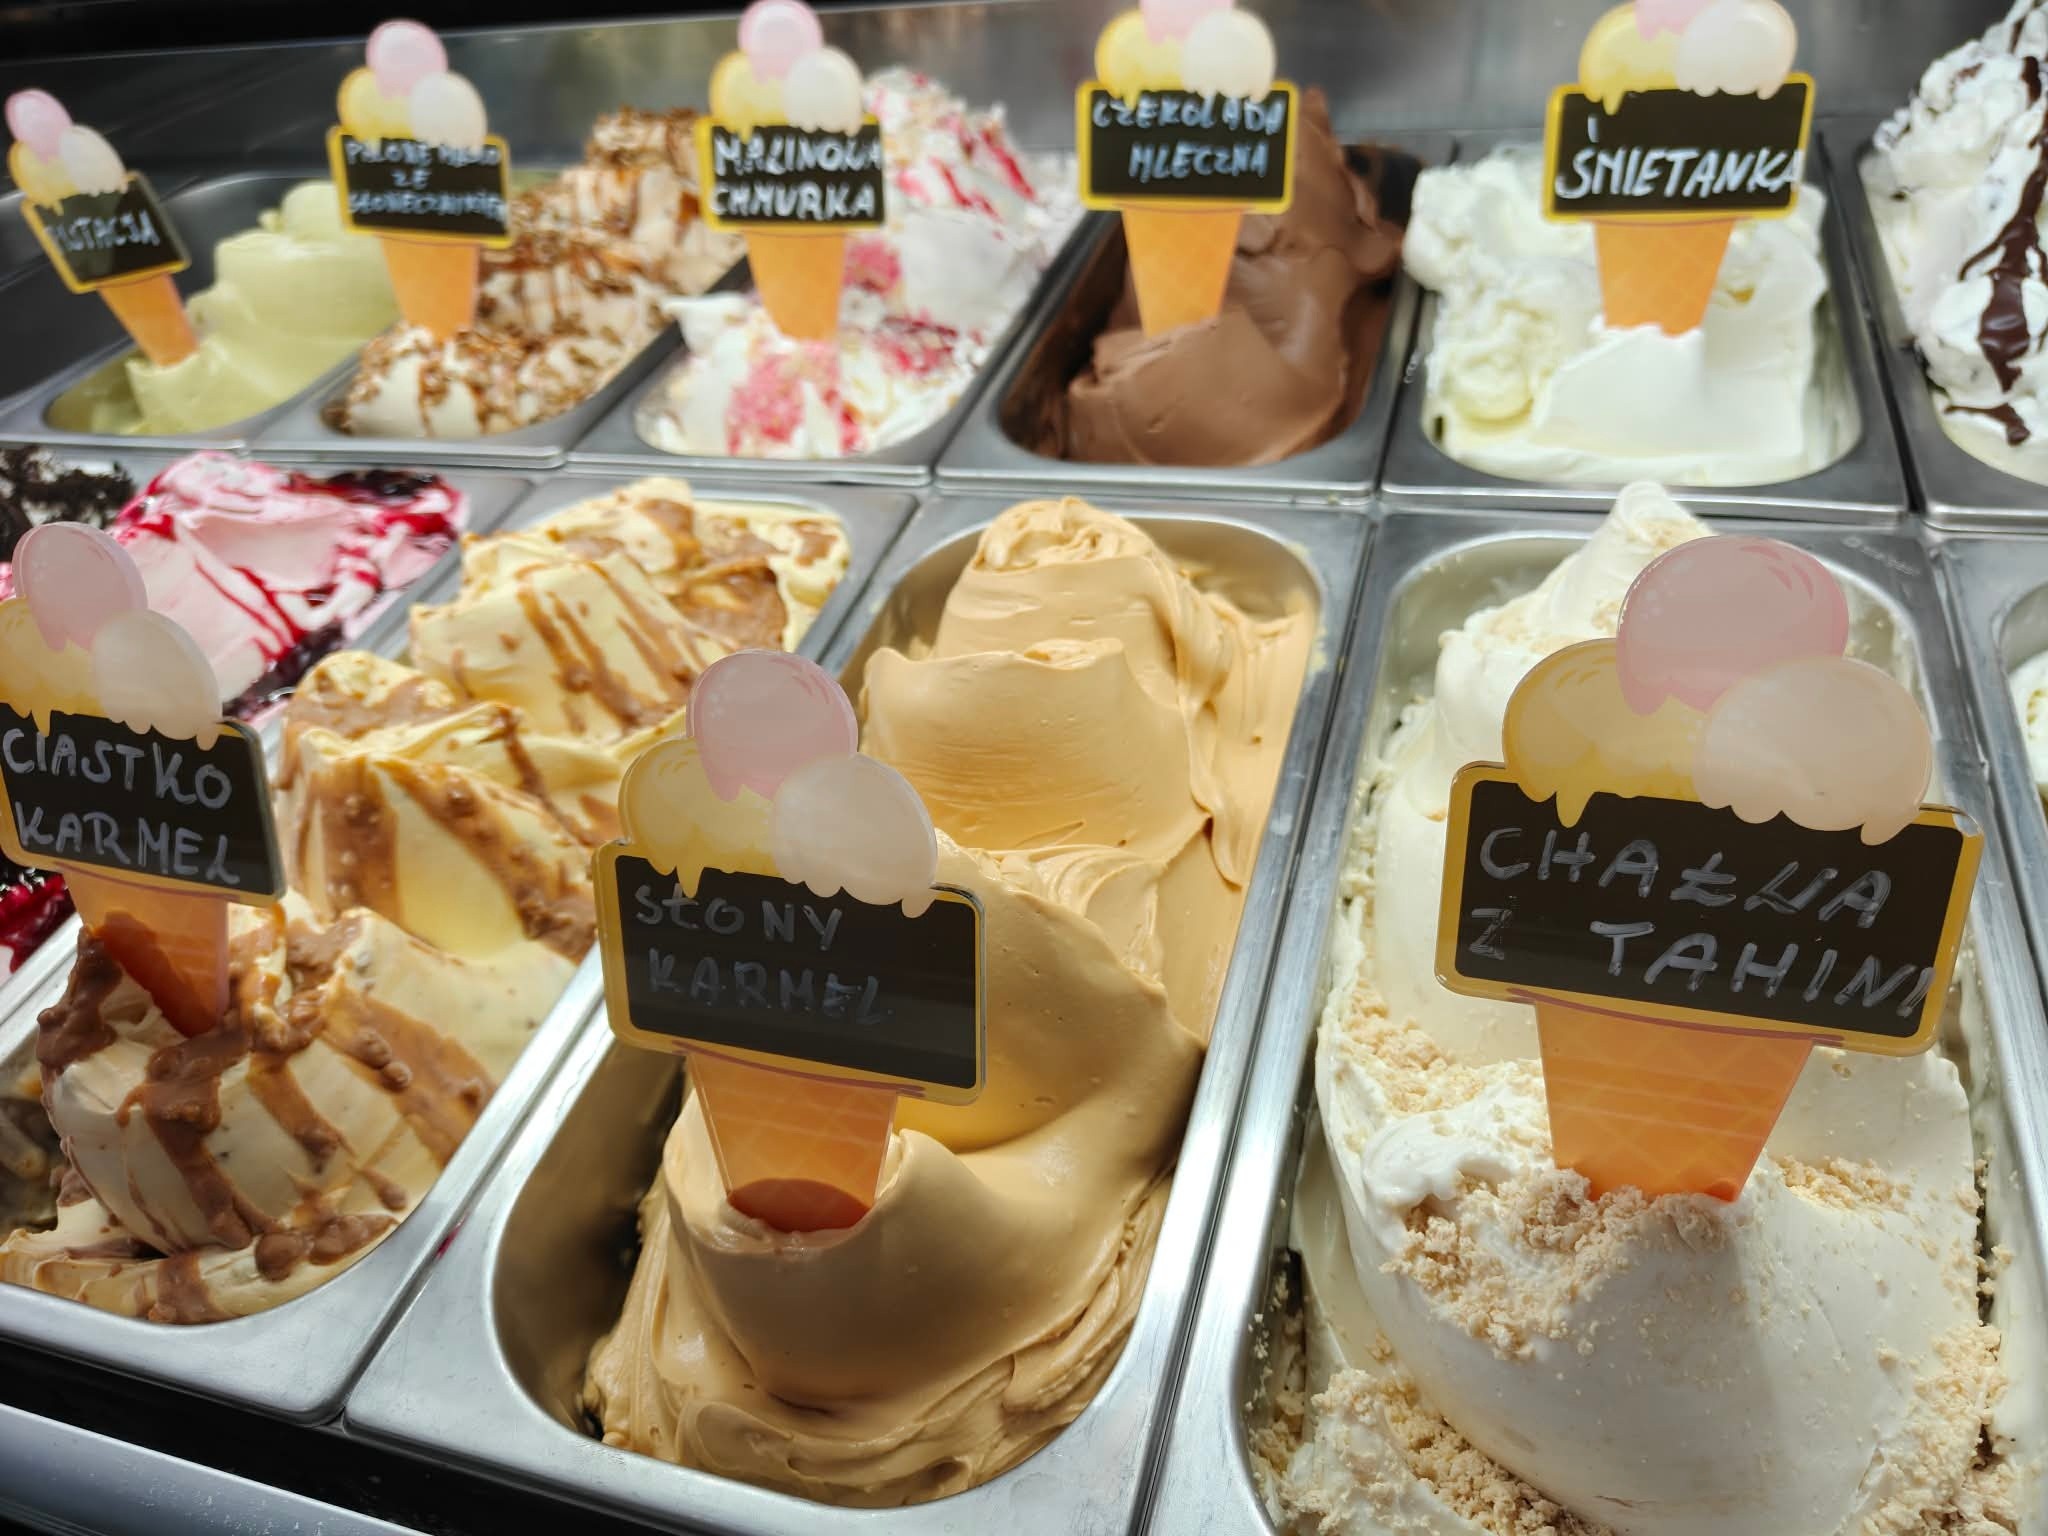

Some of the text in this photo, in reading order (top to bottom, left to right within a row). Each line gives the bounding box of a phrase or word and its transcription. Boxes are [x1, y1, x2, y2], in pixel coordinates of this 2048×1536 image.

[1092, 95, 1287, 135] CZEKOLADA
[713, 132, 881, 176] MALINOWA
[1129, 141, 1269, 183] MLECZNA
[391, 168, 431, 189] ZE
[710, 182, 876, 220] CHMURKA
[3, 728, 232, 809] CIASTKO
[15, 801, 240, 884] KARMEL
[1469, 908, 1936, 1017] Z TAHINI
[648, 947, 895, 1025] KARMEL
